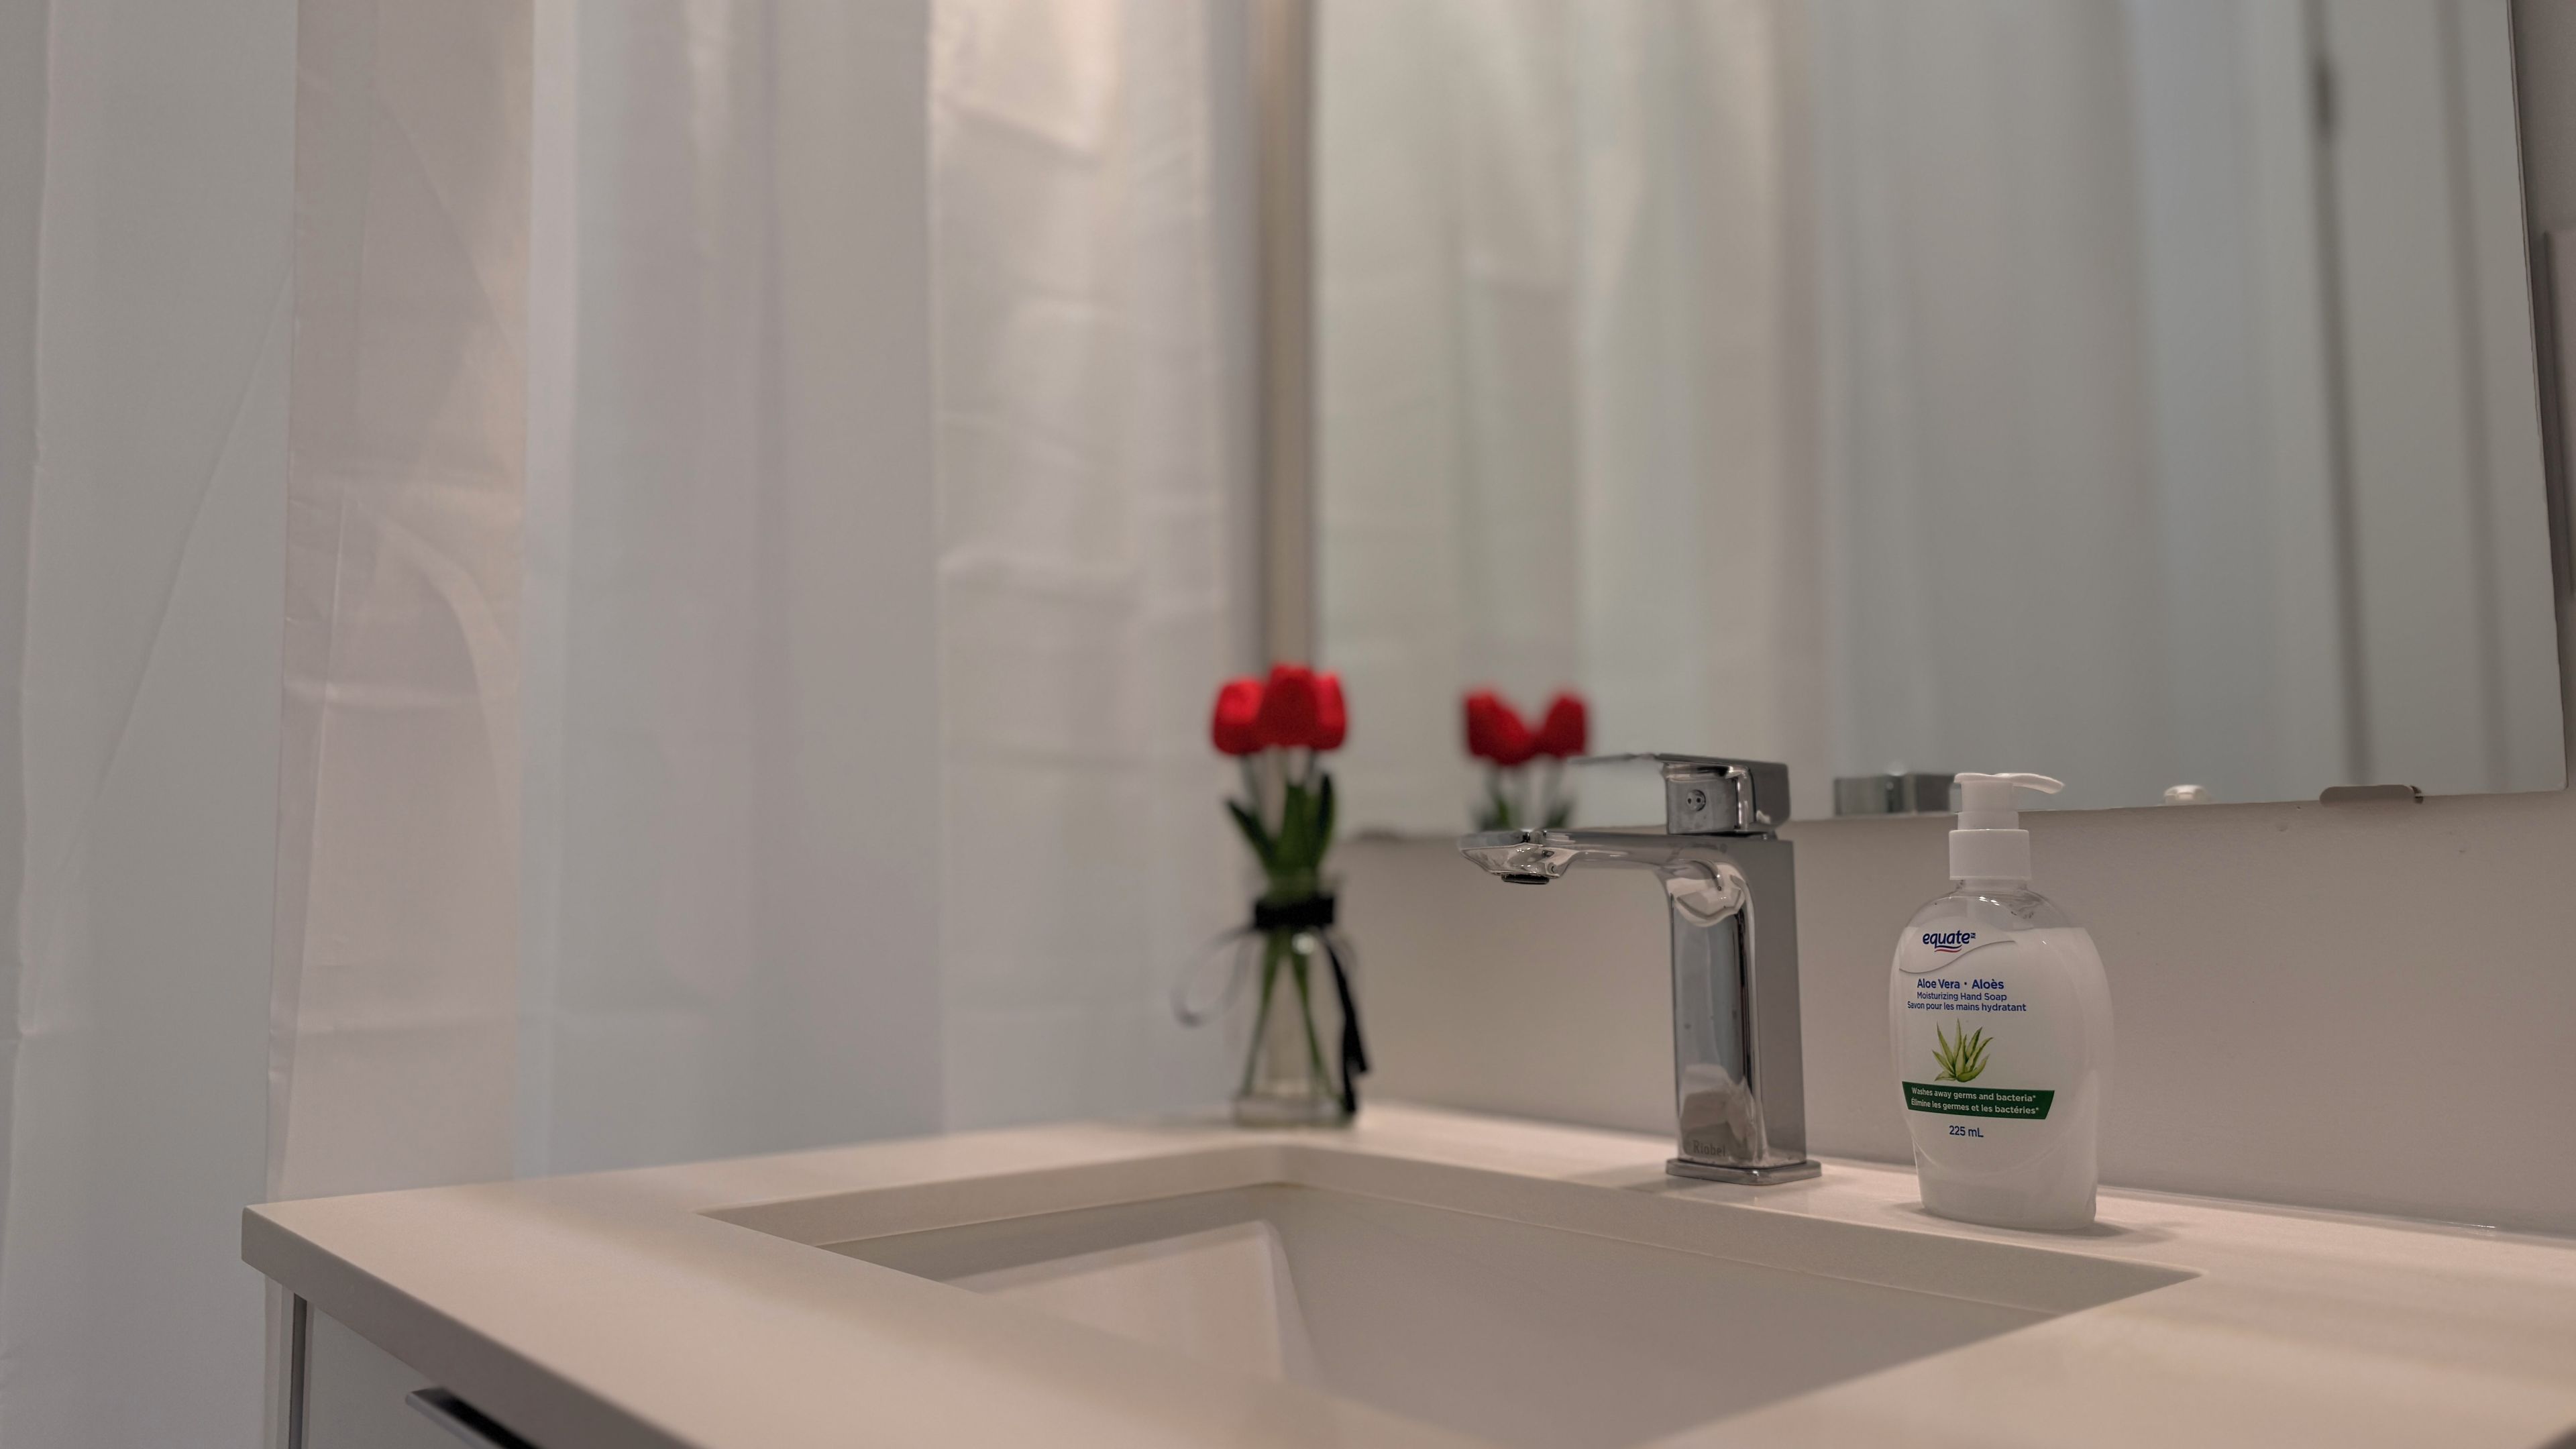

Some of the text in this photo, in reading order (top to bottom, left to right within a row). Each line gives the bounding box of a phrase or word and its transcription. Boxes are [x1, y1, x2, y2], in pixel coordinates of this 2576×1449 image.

[1923, 930, 1970, 949] equate
[1917, 979, 2004, 989] Aloe Vera Aloès
[1917, 991, 2007, 1002] Moisturizing Hand Soap
[1907, 1001, 2027, 1012] Savon pour les mains hydratant
[1912, 1087, 1933, 1096] Washes
[1934, 1090, 1952, 1099] away
[1953, 1092, 1977, 1101] germs
[1979, 1093, 1994, 1101] and
[1911, 1097, 1931, 1108] Élimine
[1932, 1100, 1941, 1109] les
[1943, 1104, 1970, 1112] germes
[1971, 1104, 1979, 1112] et
[1981, 1104, 1992, 1112] les
[1949, 1125, 1984, 1138] 225 mL
